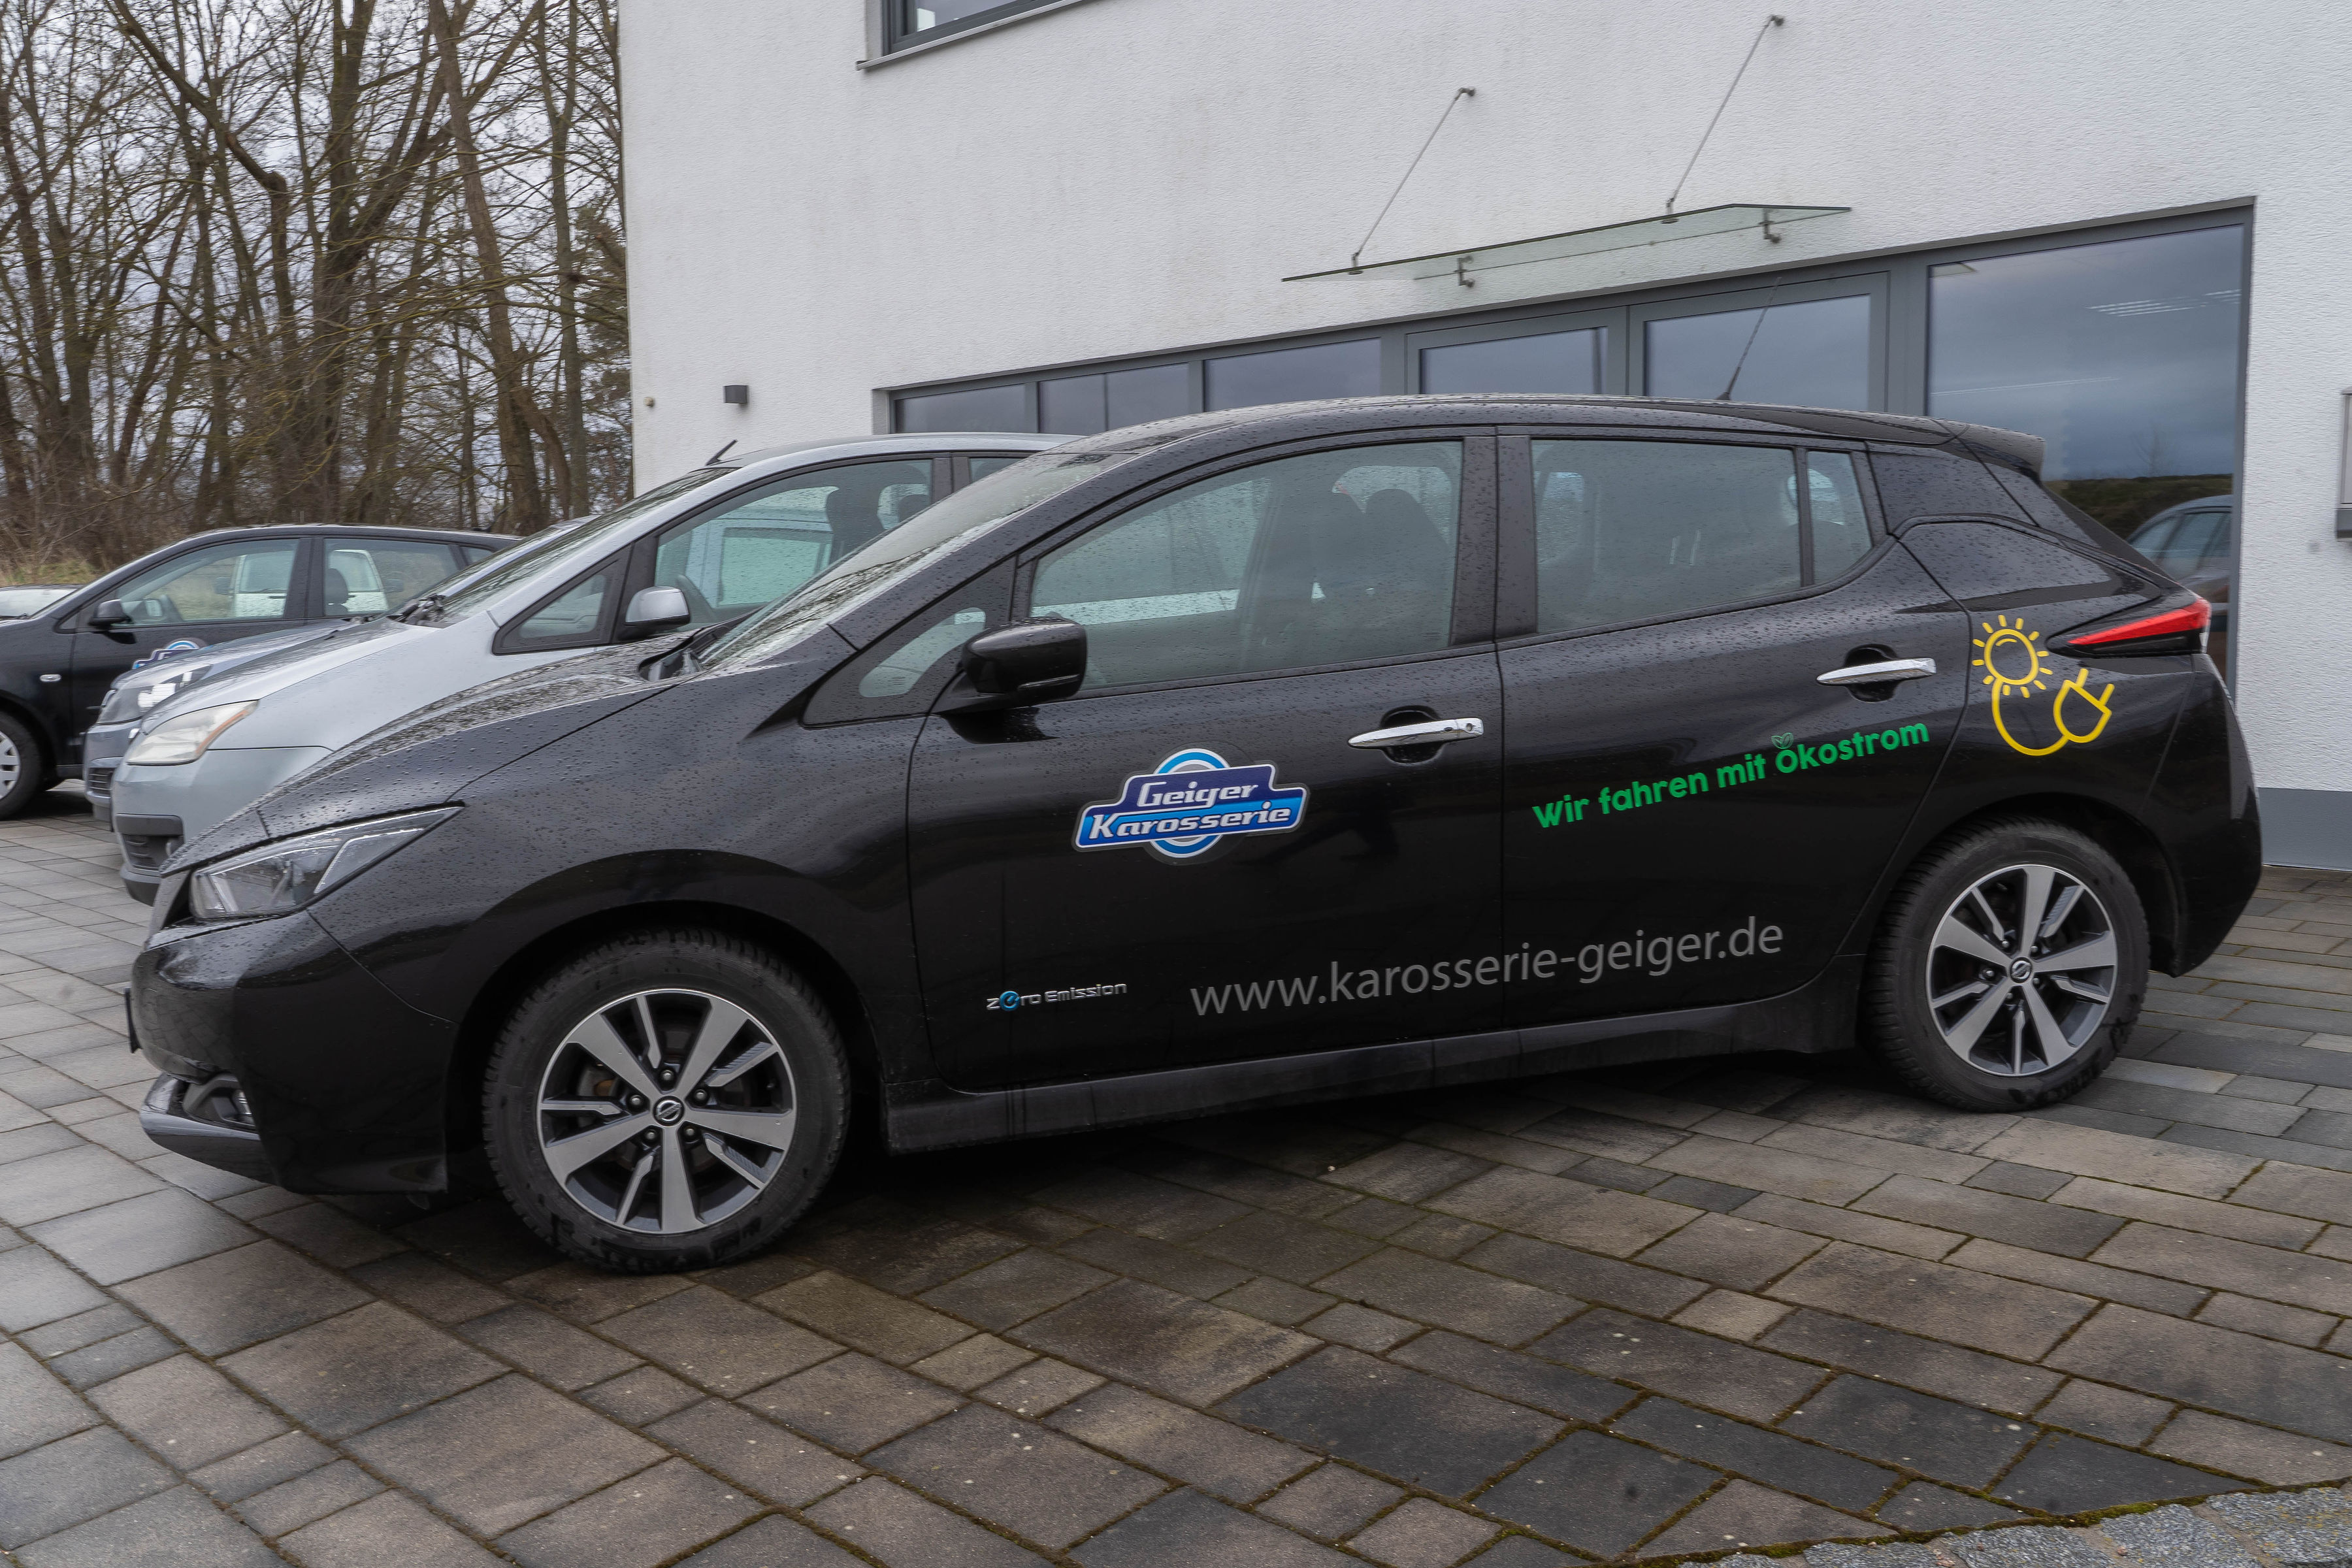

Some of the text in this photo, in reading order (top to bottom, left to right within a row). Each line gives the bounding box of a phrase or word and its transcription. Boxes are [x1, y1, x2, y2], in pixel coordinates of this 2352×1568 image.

[1137, 781, 1258, 809] Geiger
[1531, 723, 1930, 828] Wir fahren mit Ökostrom
[1088, 801, 1292, 840] Karosserie
[1190, 916, 1784, 1017] www.karosserie-geiger.de
[1045, 983, 1127, 1003] Emission
